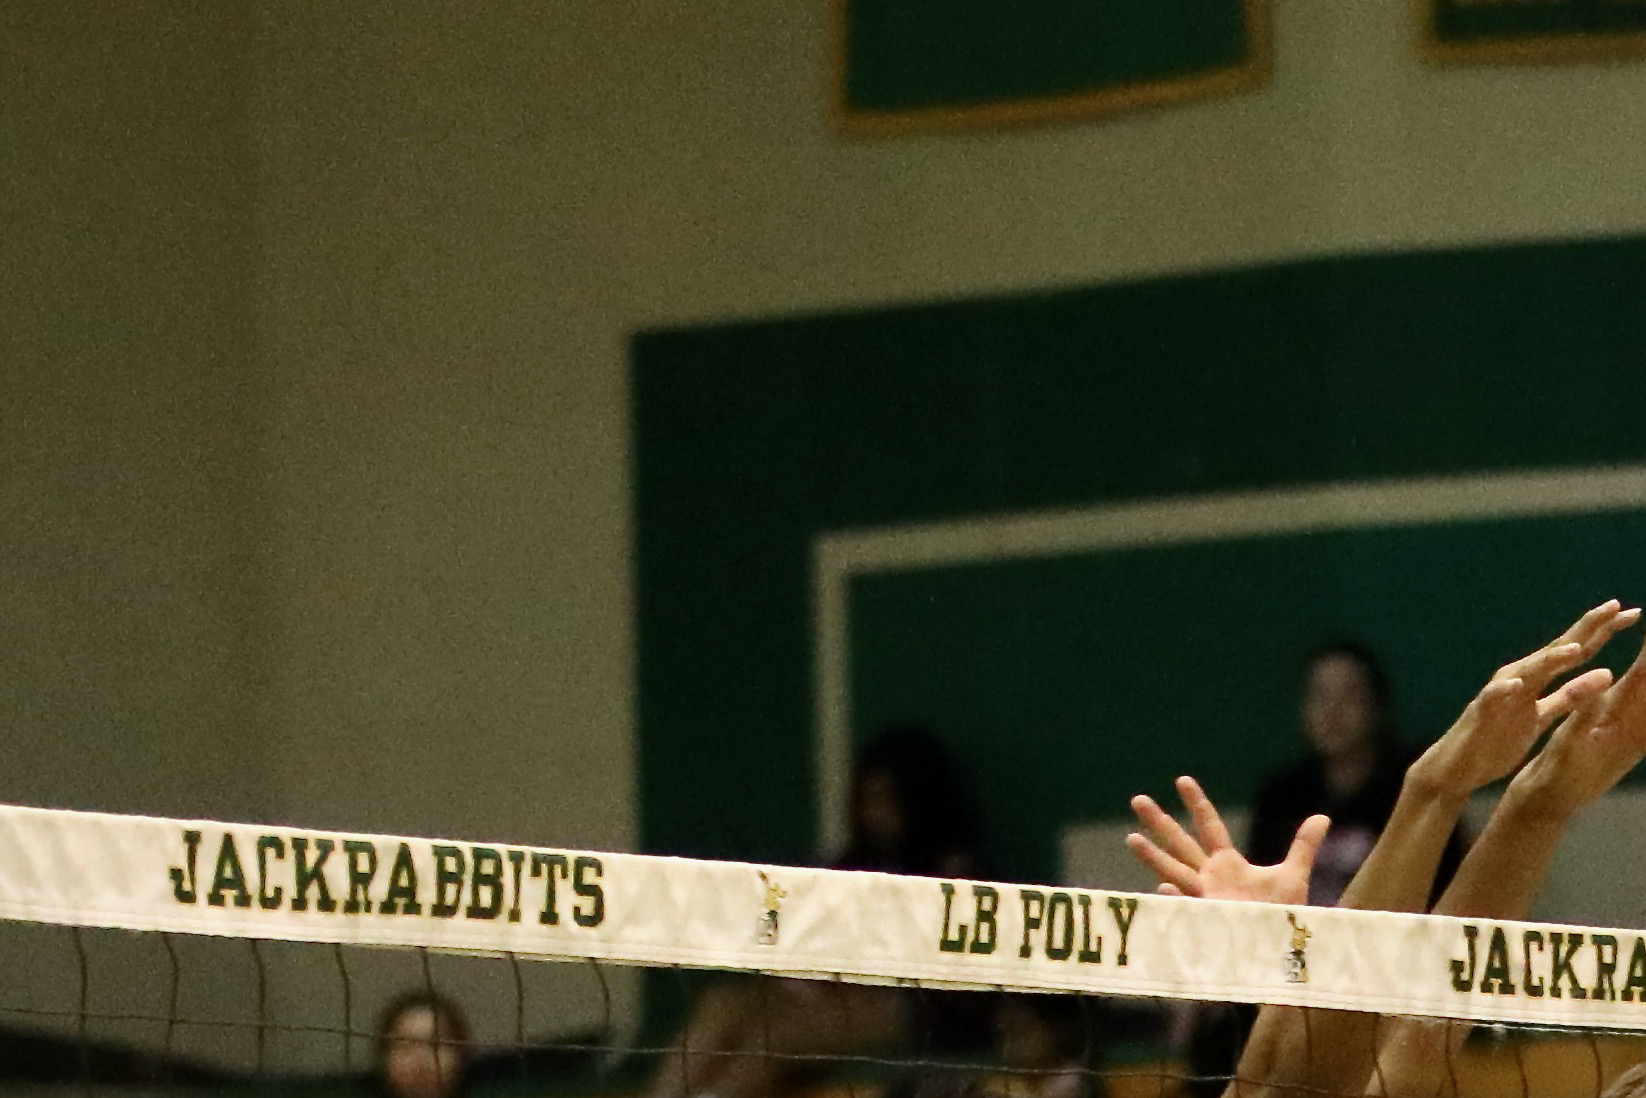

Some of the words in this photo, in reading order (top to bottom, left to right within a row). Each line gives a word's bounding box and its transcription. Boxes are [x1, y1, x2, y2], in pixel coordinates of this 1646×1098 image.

[169, 830, 605, 928] JACKRABBITS
[939, 882, 998, 955] LB
[1018, 889, 1138, 966] POLY
